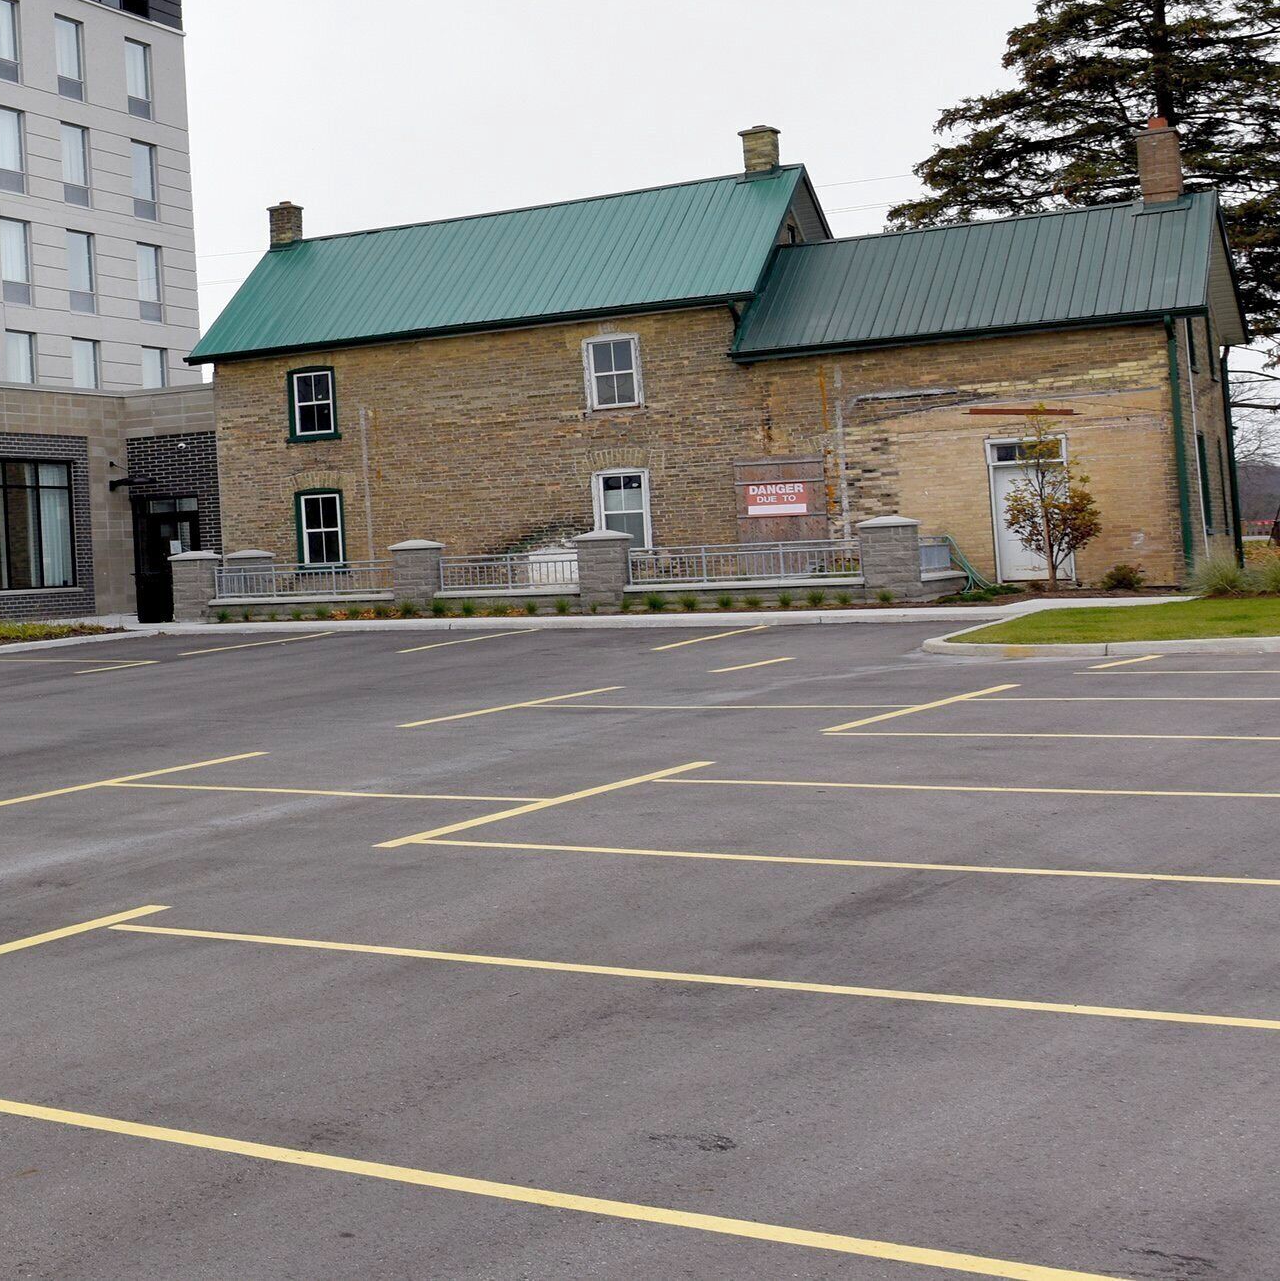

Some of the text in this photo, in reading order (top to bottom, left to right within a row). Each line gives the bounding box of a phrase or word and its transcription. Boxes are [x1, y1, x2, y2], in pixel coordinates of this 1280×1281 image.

[749, 483, 804, 495] DANGER
[756, 494, 796, 503] DUE TO
